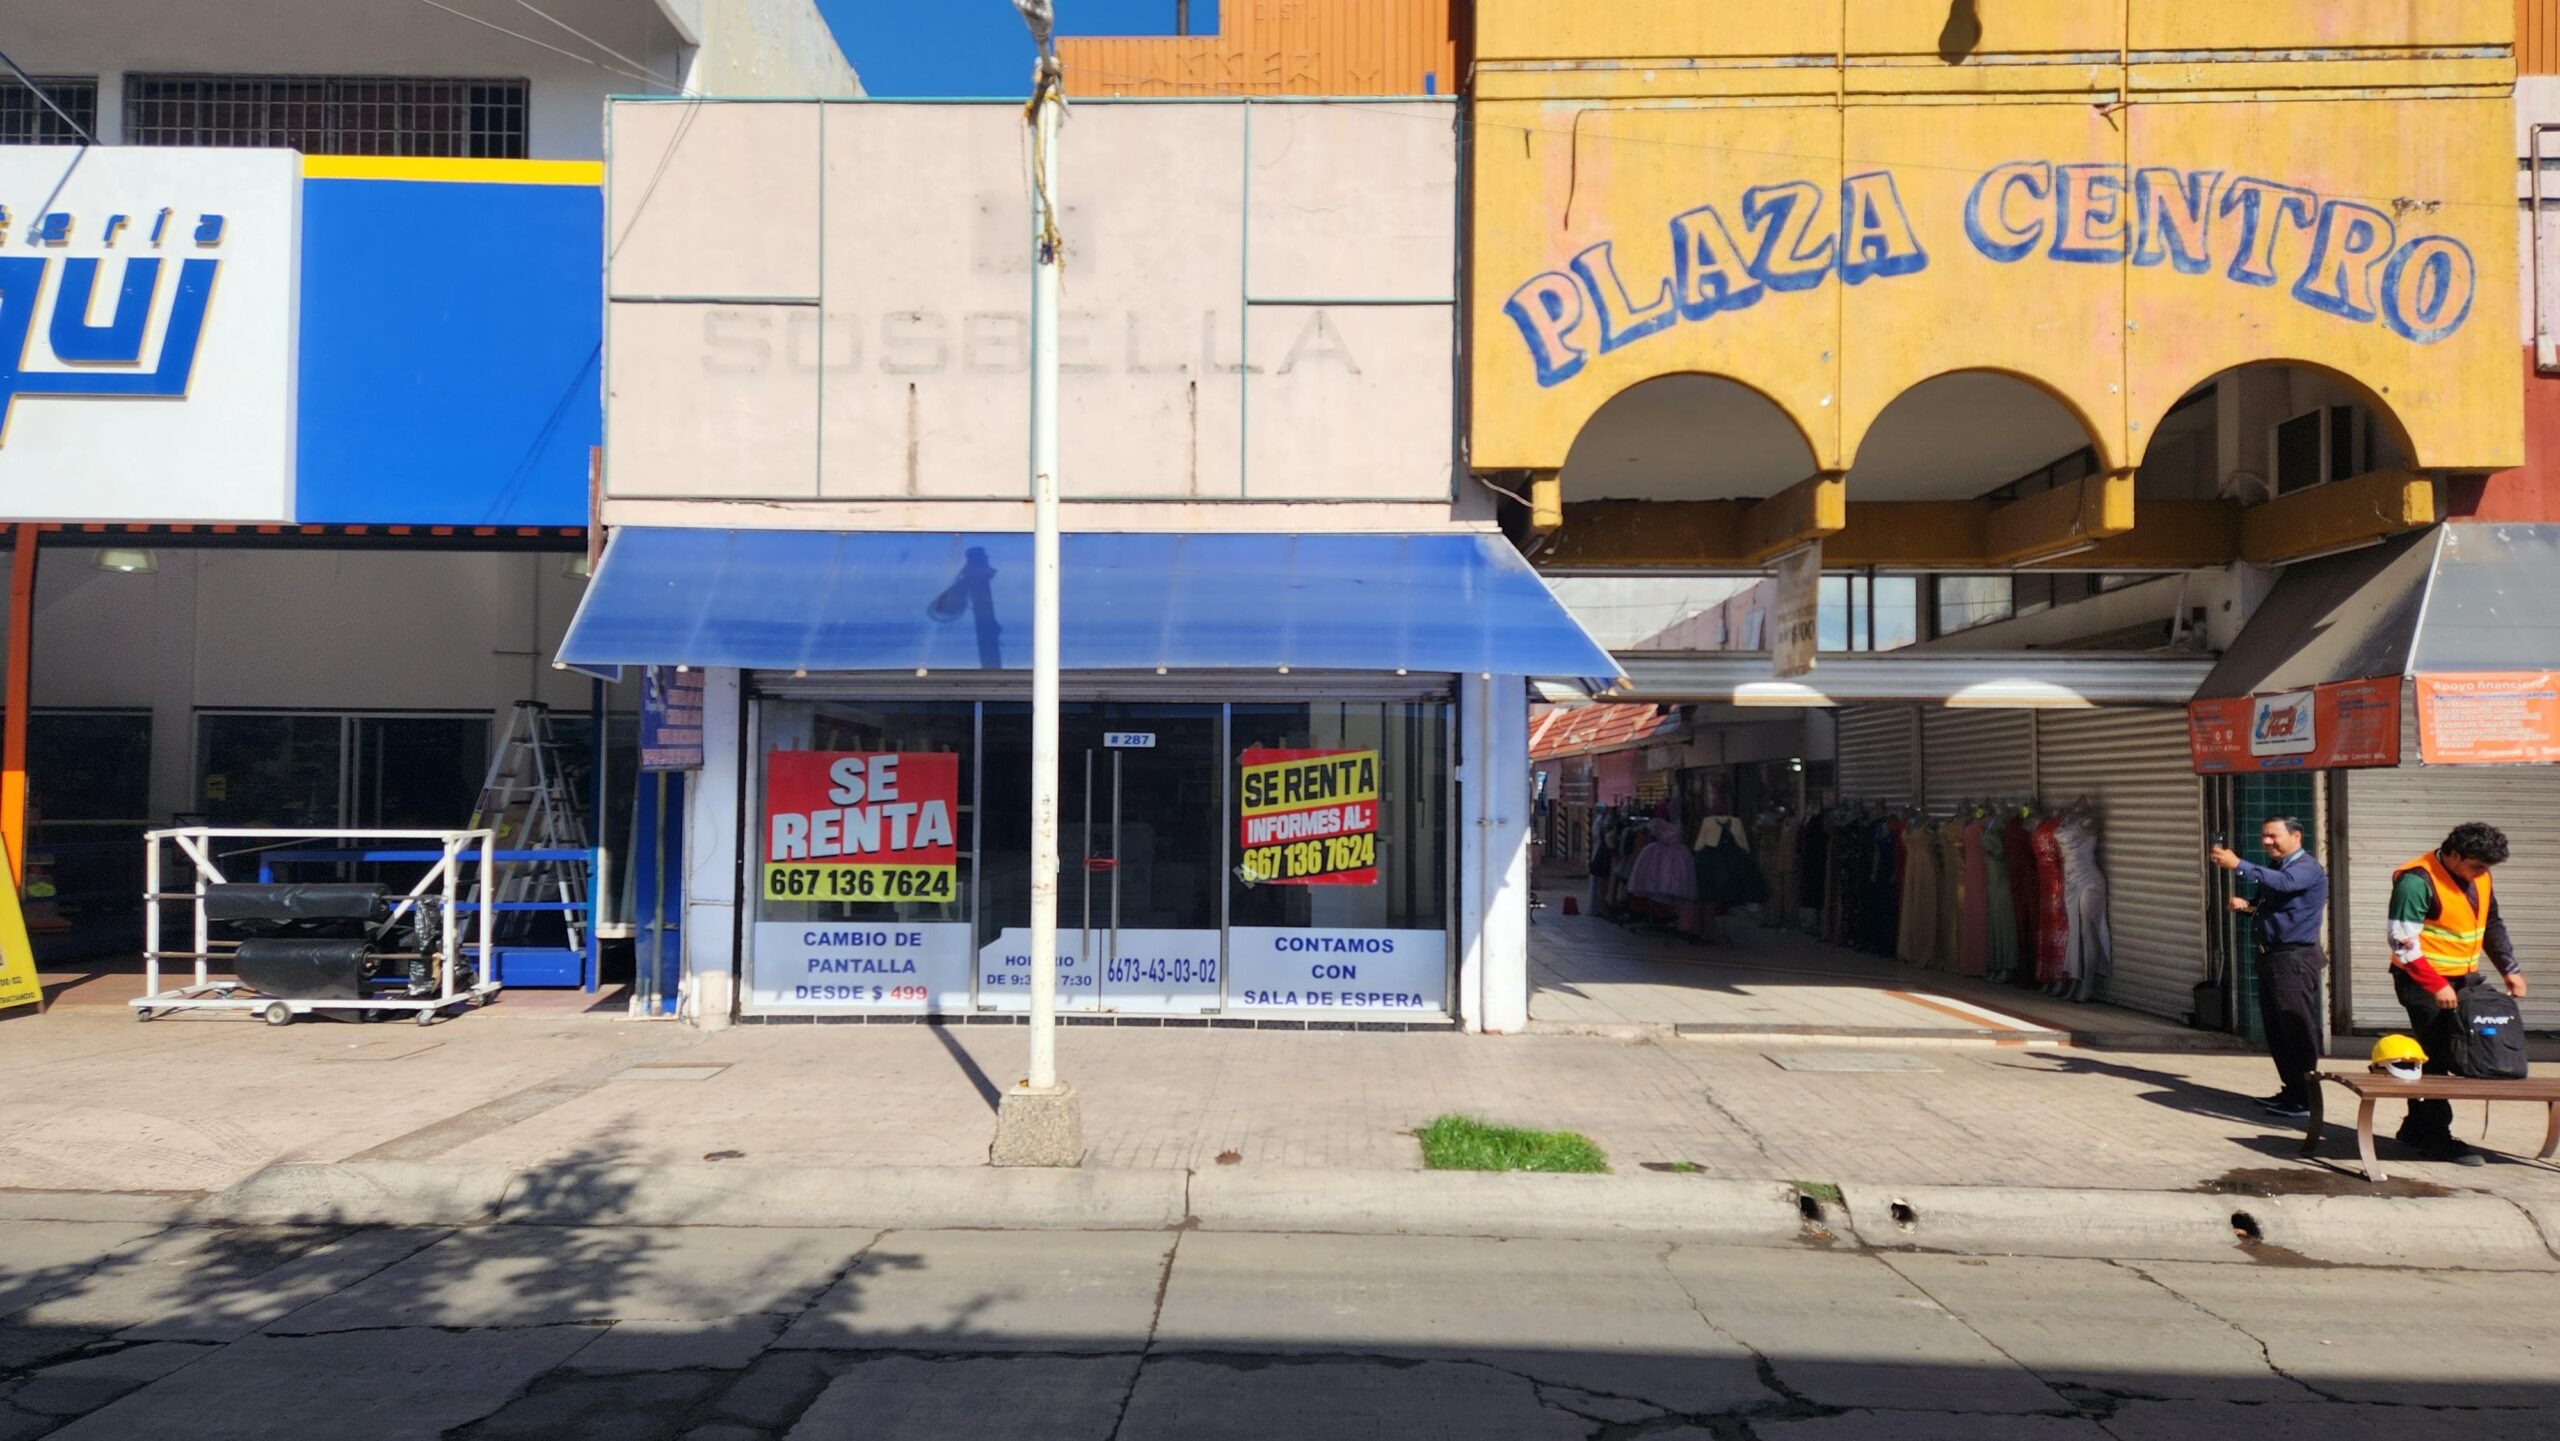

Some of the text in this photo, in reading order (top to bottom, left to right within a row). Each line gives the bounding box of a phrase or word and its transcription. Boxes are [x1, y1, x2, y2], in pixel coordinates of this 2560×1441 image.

[1502, 161, 2476, 387] PLAZA CENTRO
[702, 310, 1361, 375] SOSBELLA
[1124, 735, 1149, 745] 287
[828, 754, 898, 807] SE
[1245, 758, 1375, 809] SE RENTA
[772, 800, 953, 863] RENTA
[1247, 805, 1371, 844] INFORMES AL:
[1243, 832, 1375, 881] 667 136 7624
[770, 869, 949, 897] 667 136 7624
[803, 931, 923, 947] CAMBIO DE
[1274, 937, 1395, 953] CONTAMOS
[808, 958, 917, 974] PANTALLA
[1107, 958, 1216, 983] 6673-43-03-02
[1311, 964, 1356, 980] CON
[986, 974, 1006, 985] DE
[1061, 975, 1092, 986] 7:30
[795, 984, 928, 1002] DESDE $ 499
[1244, 990, 1423, 1008] SALA DE ESPERA
